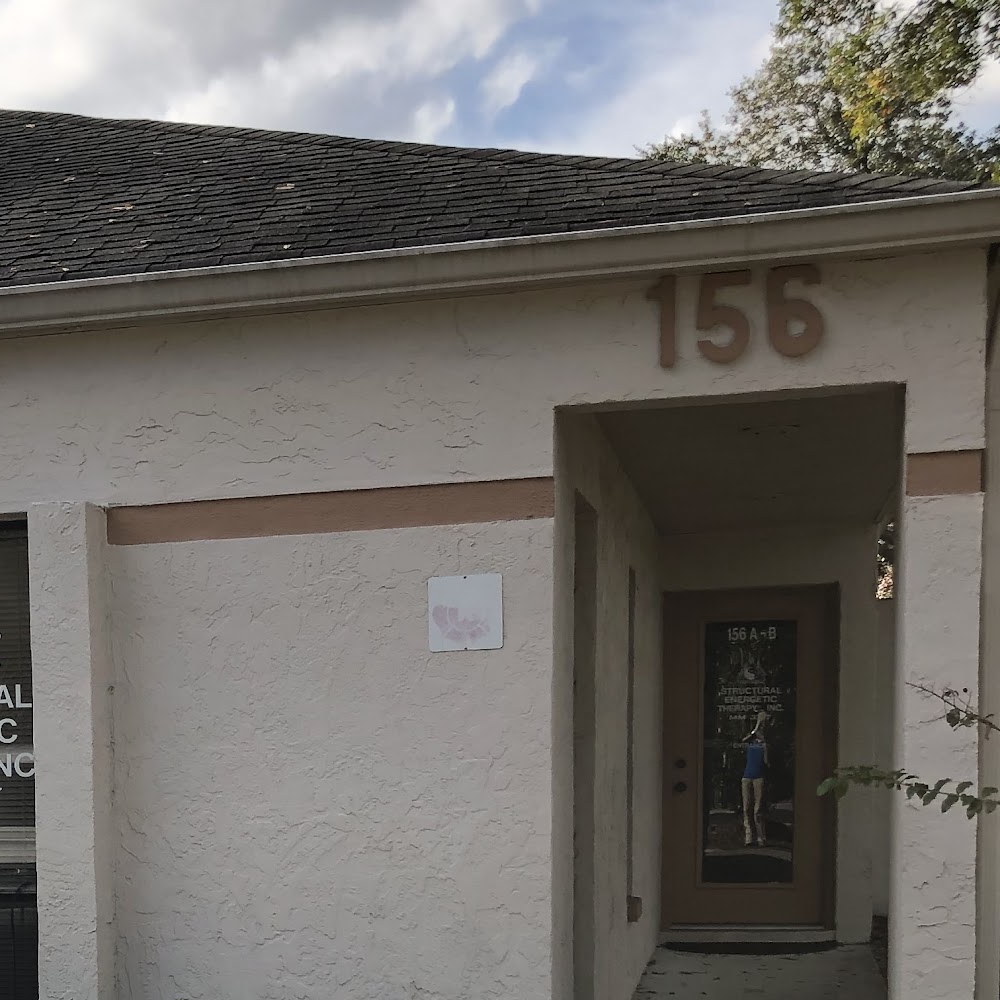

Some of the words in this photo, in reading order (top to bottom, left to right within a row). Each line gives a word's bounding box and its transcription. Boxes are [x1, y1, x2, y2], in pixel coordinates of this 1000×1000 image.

[645, 263, 825, 369] 156
[727, 626, 747, 641] 156
[719, 686, 782, 695] STRUCTURAL
[724, 695, 778, 704] ENERGETIC
